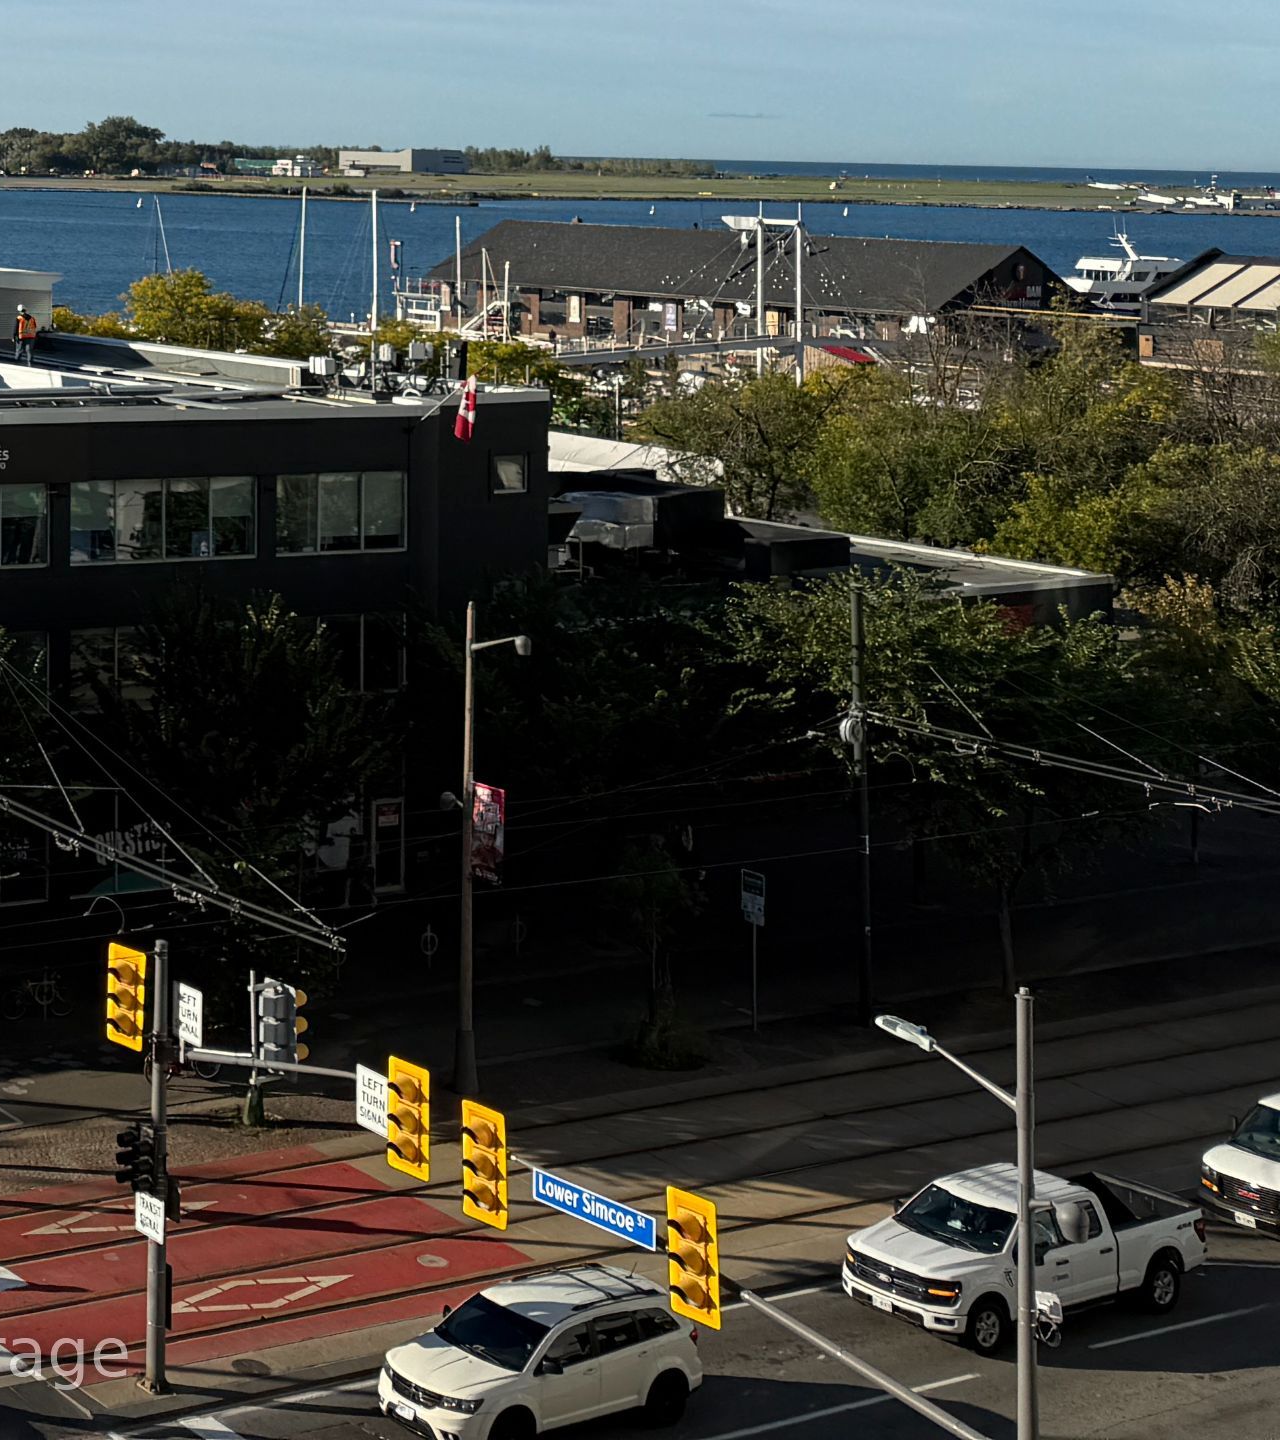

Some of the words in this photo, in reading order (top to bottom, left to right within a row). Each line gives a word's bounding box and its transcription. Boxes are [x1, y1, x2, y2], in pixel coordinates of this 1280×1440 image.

[362, 1075, 384, 1095] LEFT
[361, 1090, 386, 1112] TURN
[359, 1106, 387, 1129] SIGNAL
[538, 1173, 580, 1208] Lower
[582, 1192, 635, 1233] Simcoe
[636, 1215, 647, 1229] St
